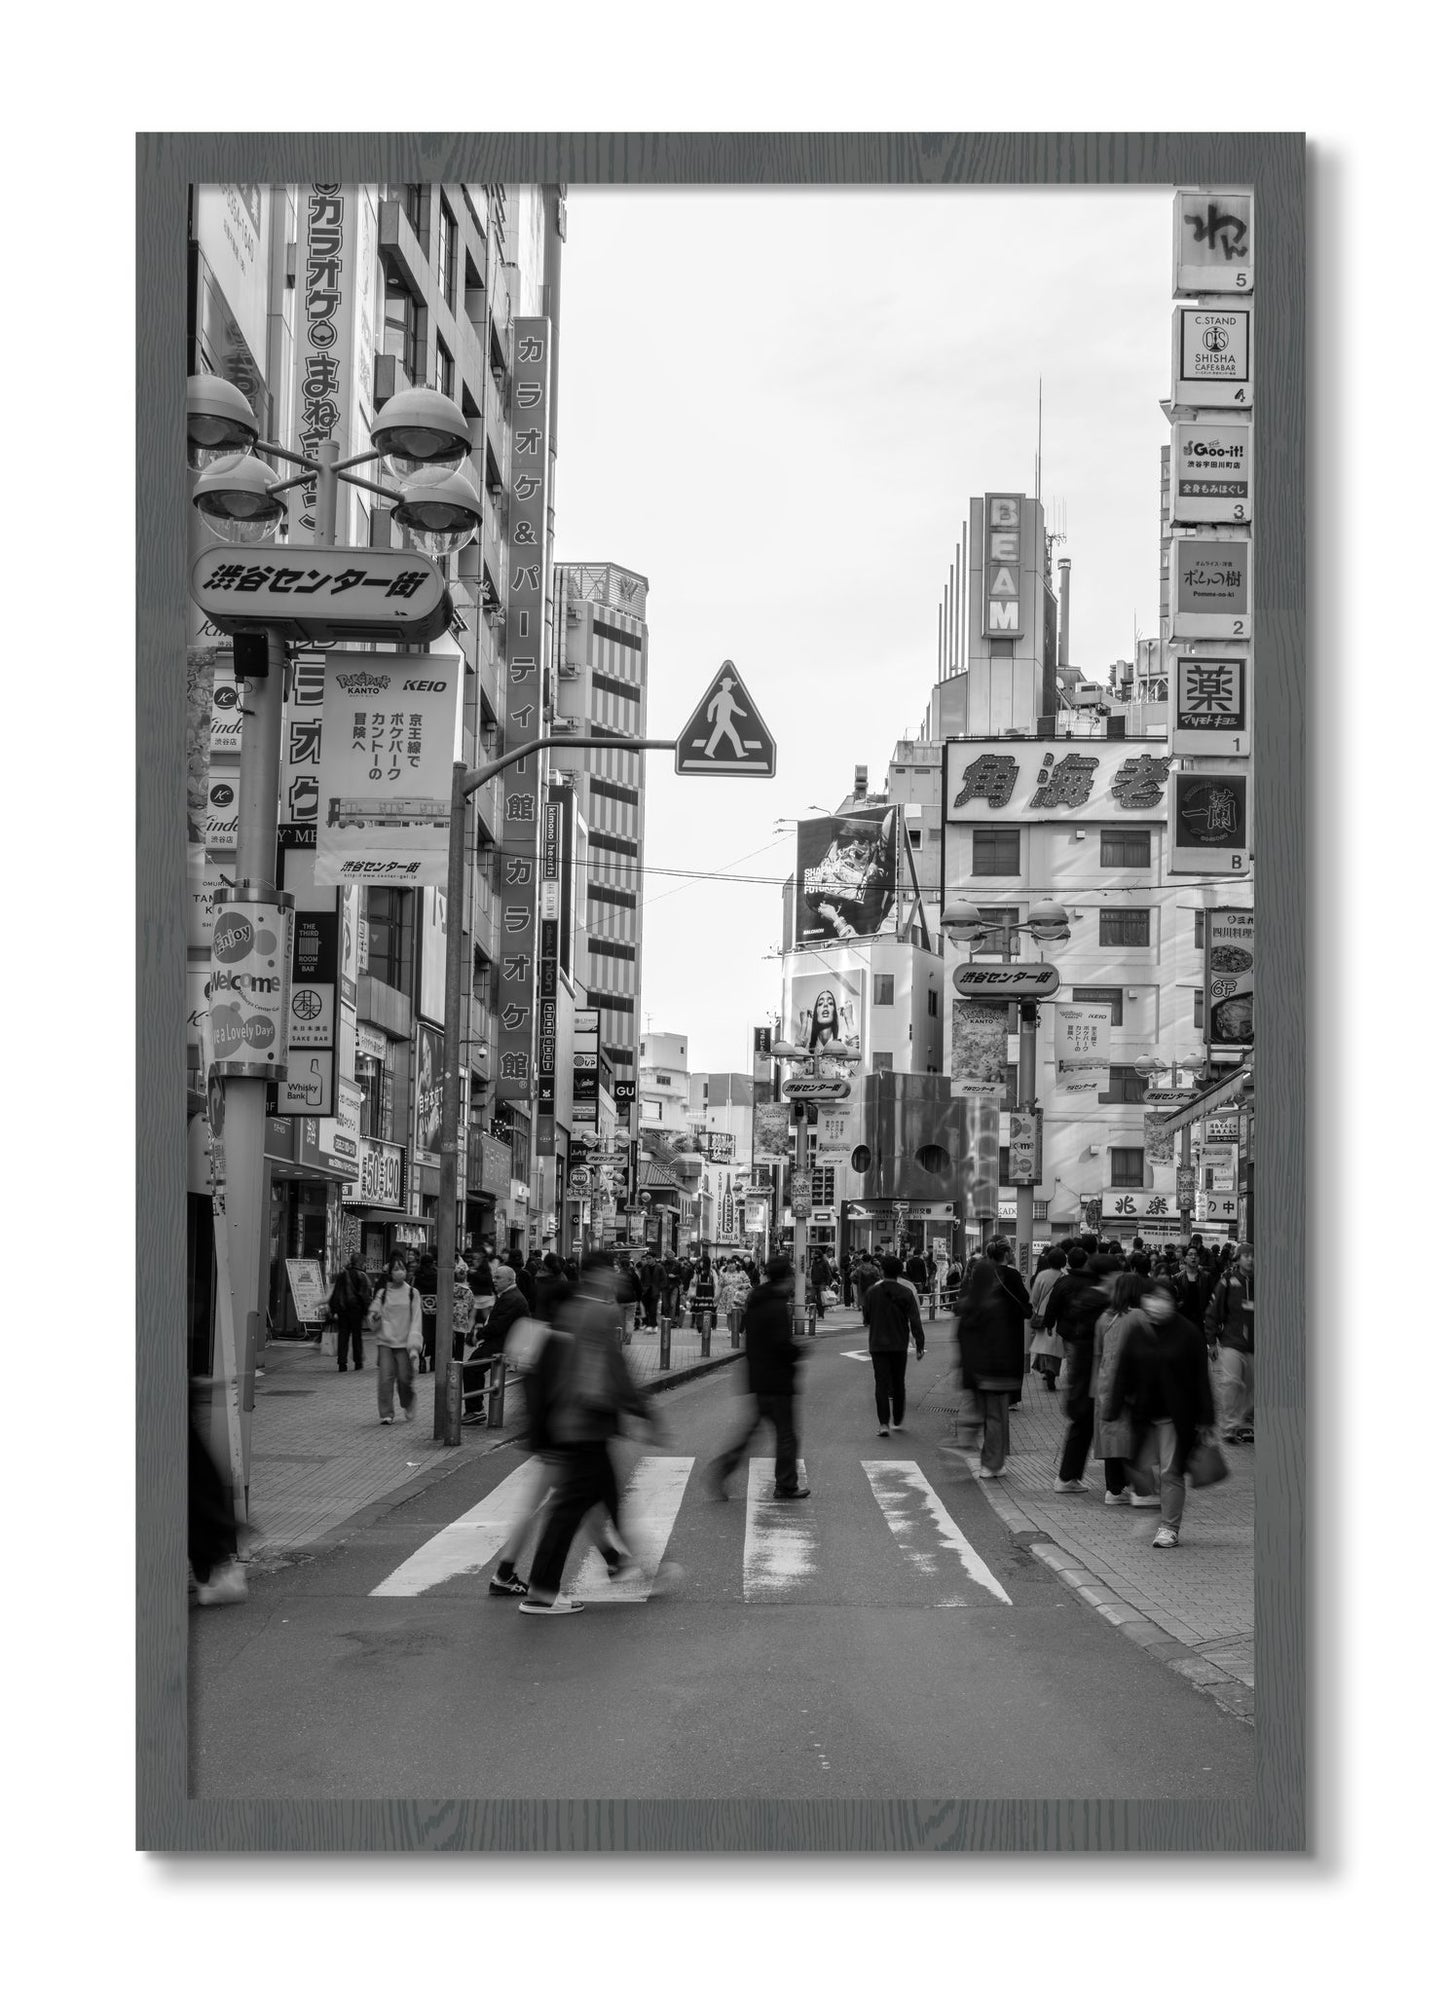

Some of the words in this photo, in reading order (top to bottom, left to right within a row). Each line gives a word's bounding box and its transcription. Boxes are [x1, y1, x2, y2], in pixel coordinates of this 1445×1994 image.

[306, 195, 344, 321] カラオケ
[1236, 274, 1246, 287] 5
[1195, 316, 1237, 325] C.STAND
[1195, 354, 1236, 363] SHISHA
[1194, 443, 1243, 457] Goo-it!
[1183, 483, 1244, 494] 全身もみほぐし
[1234, 504, 1244, 520] 3
[989, 499, 1020, 630] BEAM
[202, 564, 430, 599] 渋谷センター街
[1184, 569, 1242, 588] ポムの樹
[1233, 620, 1243, 635] 2
[348, 687, 380, 695] KANTO
[403, 680, 447, 693] KEIO
[1186, 665, 1233, 711] 薬
[1181, 714, 1238, 727] マツモトキヨシ
[352, 712, 367, 751] 冒険へ
[369, 712, 385, 780] カントーの
[387, 712, 404, 780] ポケパーク
[407, 713, 423, 768] 京王線で
[1233, 739, 1240, 752] 1
[1181, 788, 1237, 833] 一蘭
[547, 807, 556, 840] kimono
[211, 835, 233, 844] 渋谷店
[341, 860, 422, 874] 渋谷センター街
[547, 844, 556, 876] hearts
[1231, 854, 1242, 869] B
[215, 924, 250, 956] Enjoy
[211, 970, 280, 993] Welcome
[960, 971, 1053, 984] 渋谷センター街
[1211, 980, 1237, 998] 6F
[227, 1023, 253, 1041] Lovely
[255, 1022, 274, 1037] Day!
[288, 1083, 319, 1092] Whisky
[616, 1087, 635, 1096] GU
[785, 1083, 842, 1092] 渋谷センター街
[724, 1194, 732, 1232] BEER
